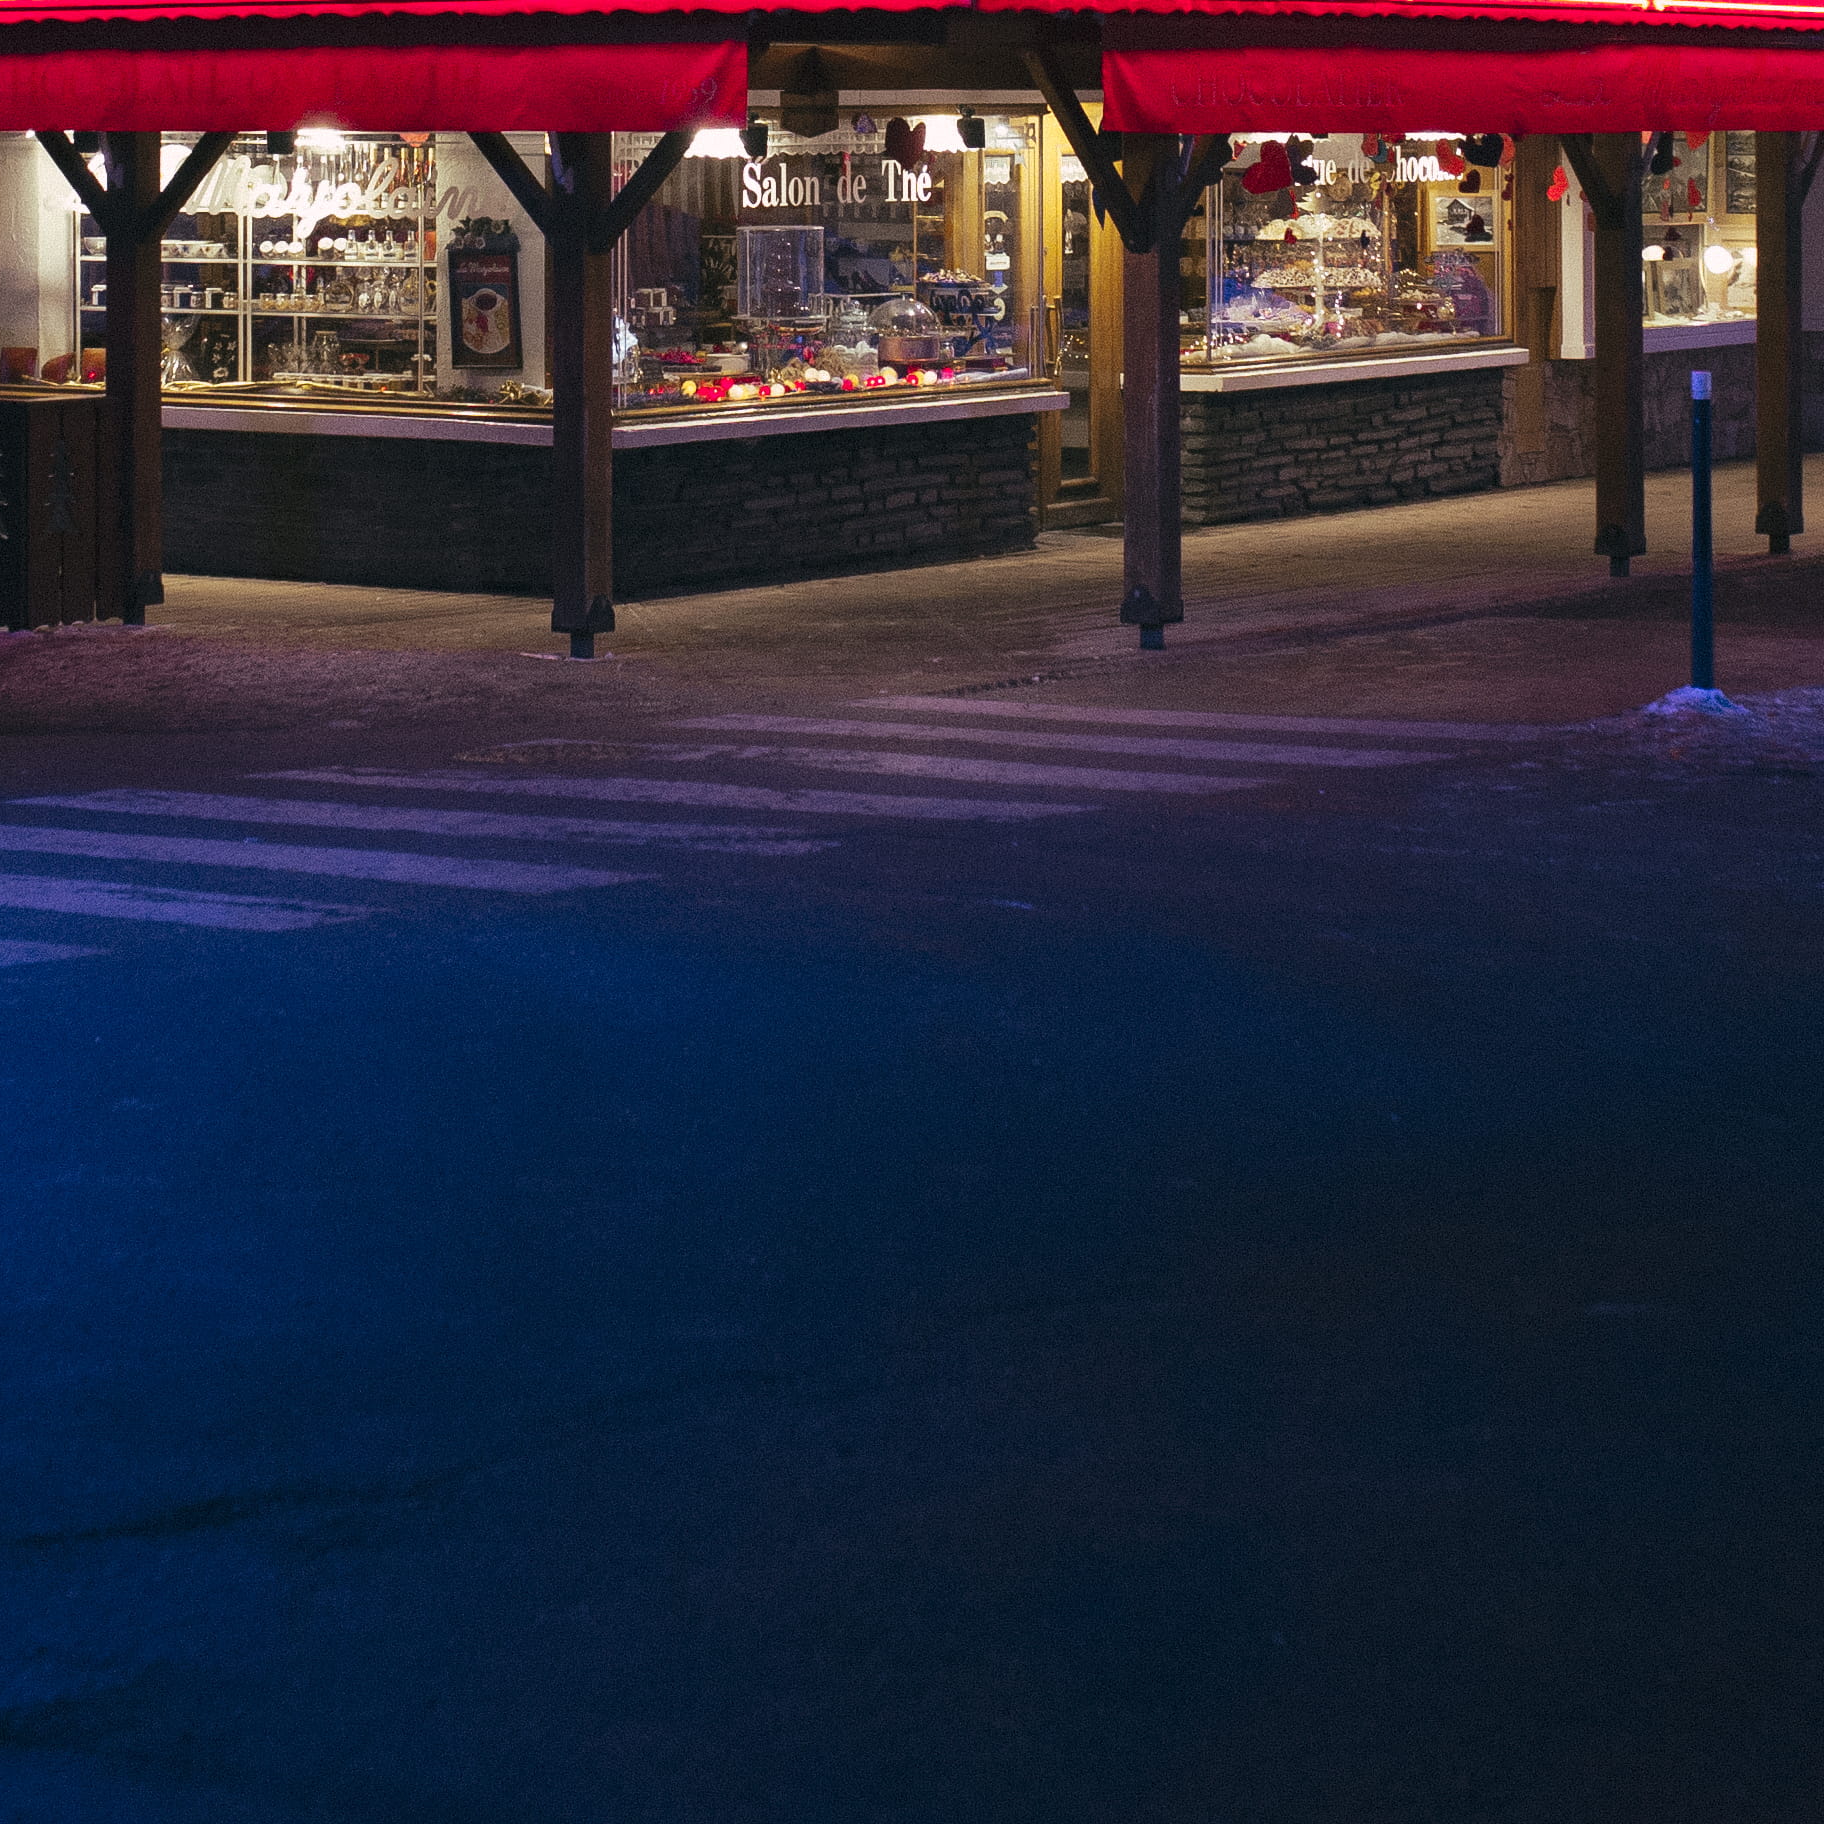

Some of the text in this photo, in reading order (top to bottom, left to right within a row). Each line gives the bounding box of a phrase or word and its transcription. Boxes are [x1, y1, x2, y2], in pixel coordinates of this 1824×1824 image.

[1170, 68, 1406, 108] CHOCOLATIER
[741, 161, 821, 209] Salon
[836, 160, 867, 204] de
